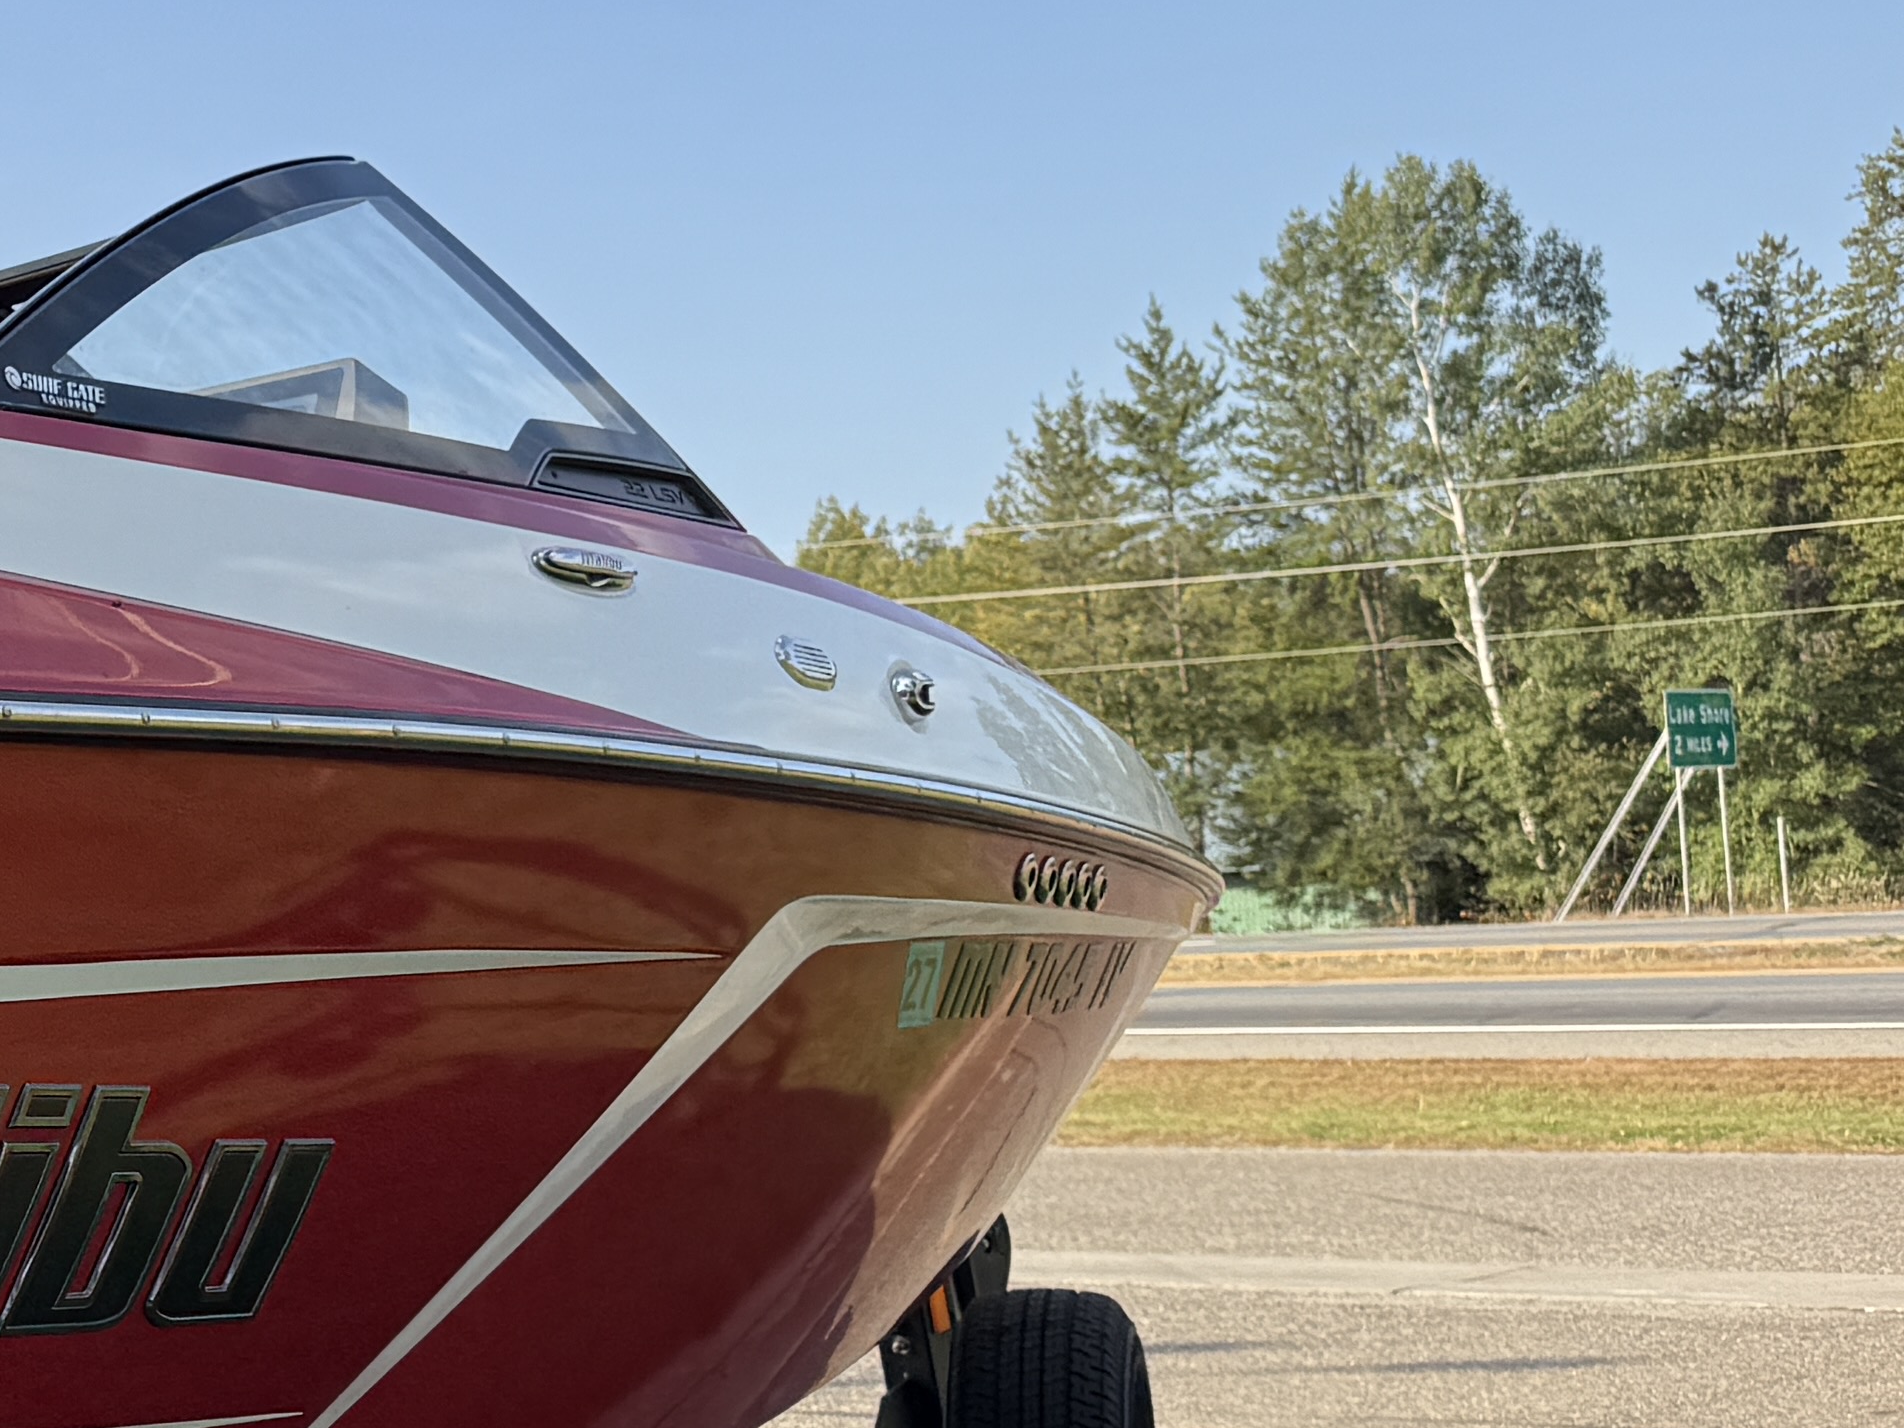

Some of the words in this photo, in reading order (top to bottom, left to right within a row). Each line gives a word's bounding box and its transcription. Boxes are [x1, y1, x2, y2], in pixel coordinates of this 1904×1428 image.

[22, 372, 61, 394] SURF
[67, 381, 106, 404] GATE
[1668, 704, 1695, 724] Lake
[1674, 735, 1683, 755] 2
[902, 957, 938, 1012] 27
